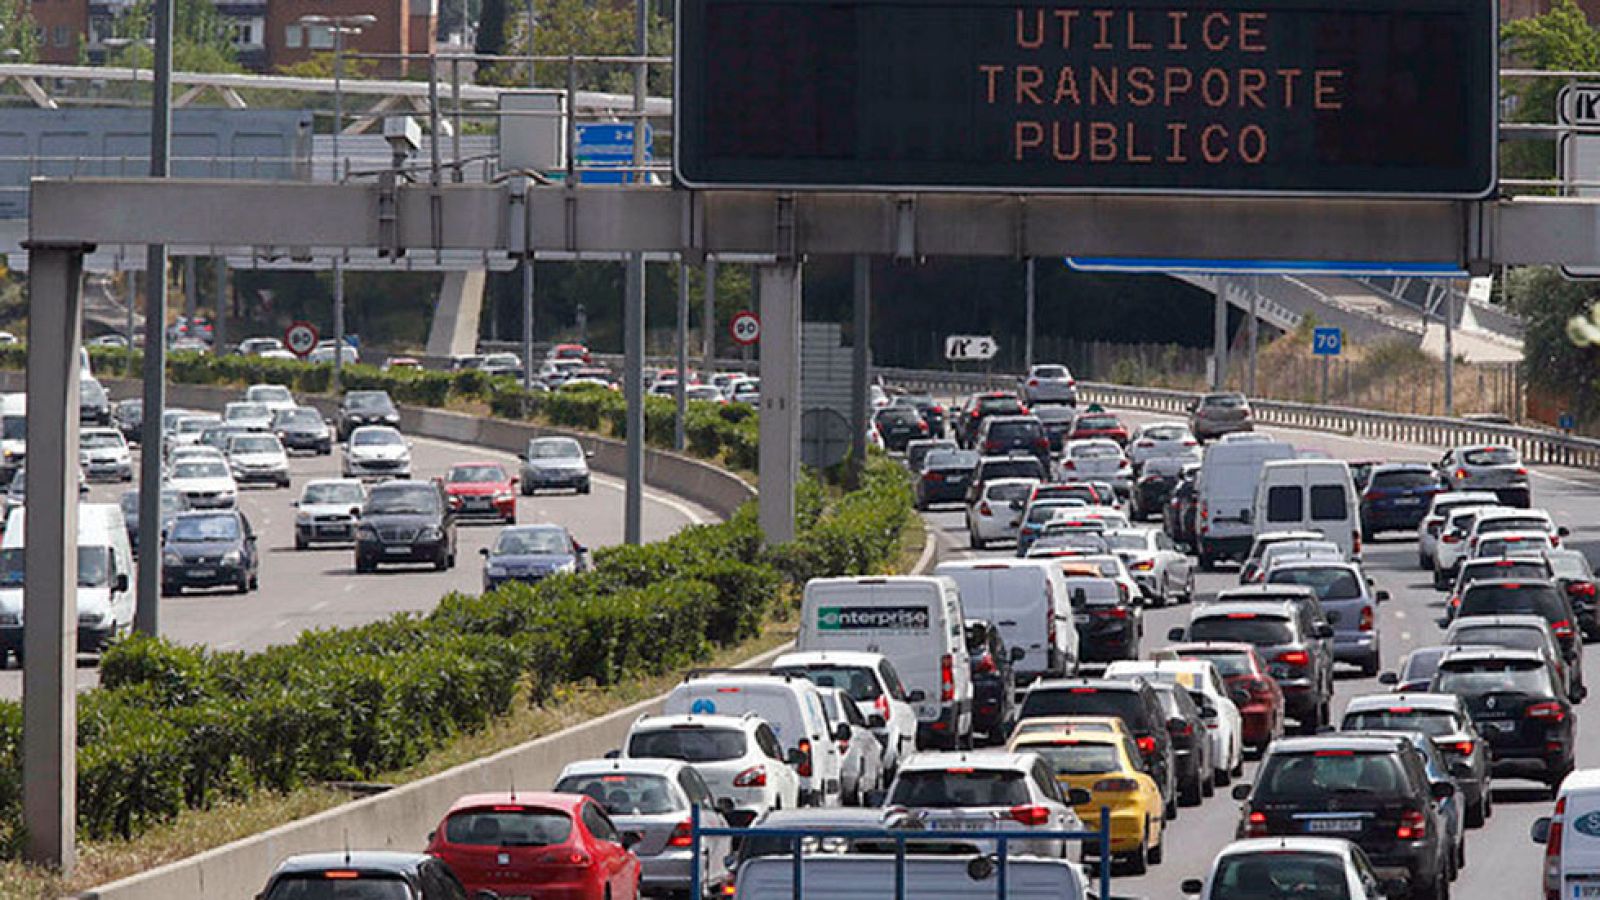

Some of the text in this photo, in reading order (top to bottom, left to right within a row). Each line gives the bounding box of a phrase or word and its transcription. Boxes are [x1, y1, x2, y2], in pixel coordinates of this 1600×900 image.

[1018, 9, 1266, 50] UTILICE
[980, 66, 1342, 109] TRANSPORTE
[1016, 121, 1267, 163] PUBLICO
[979, 341, 990, 354] 2
[1317, 334, 1338, 348] 70
[818, 610, 928, 625] enterprise
